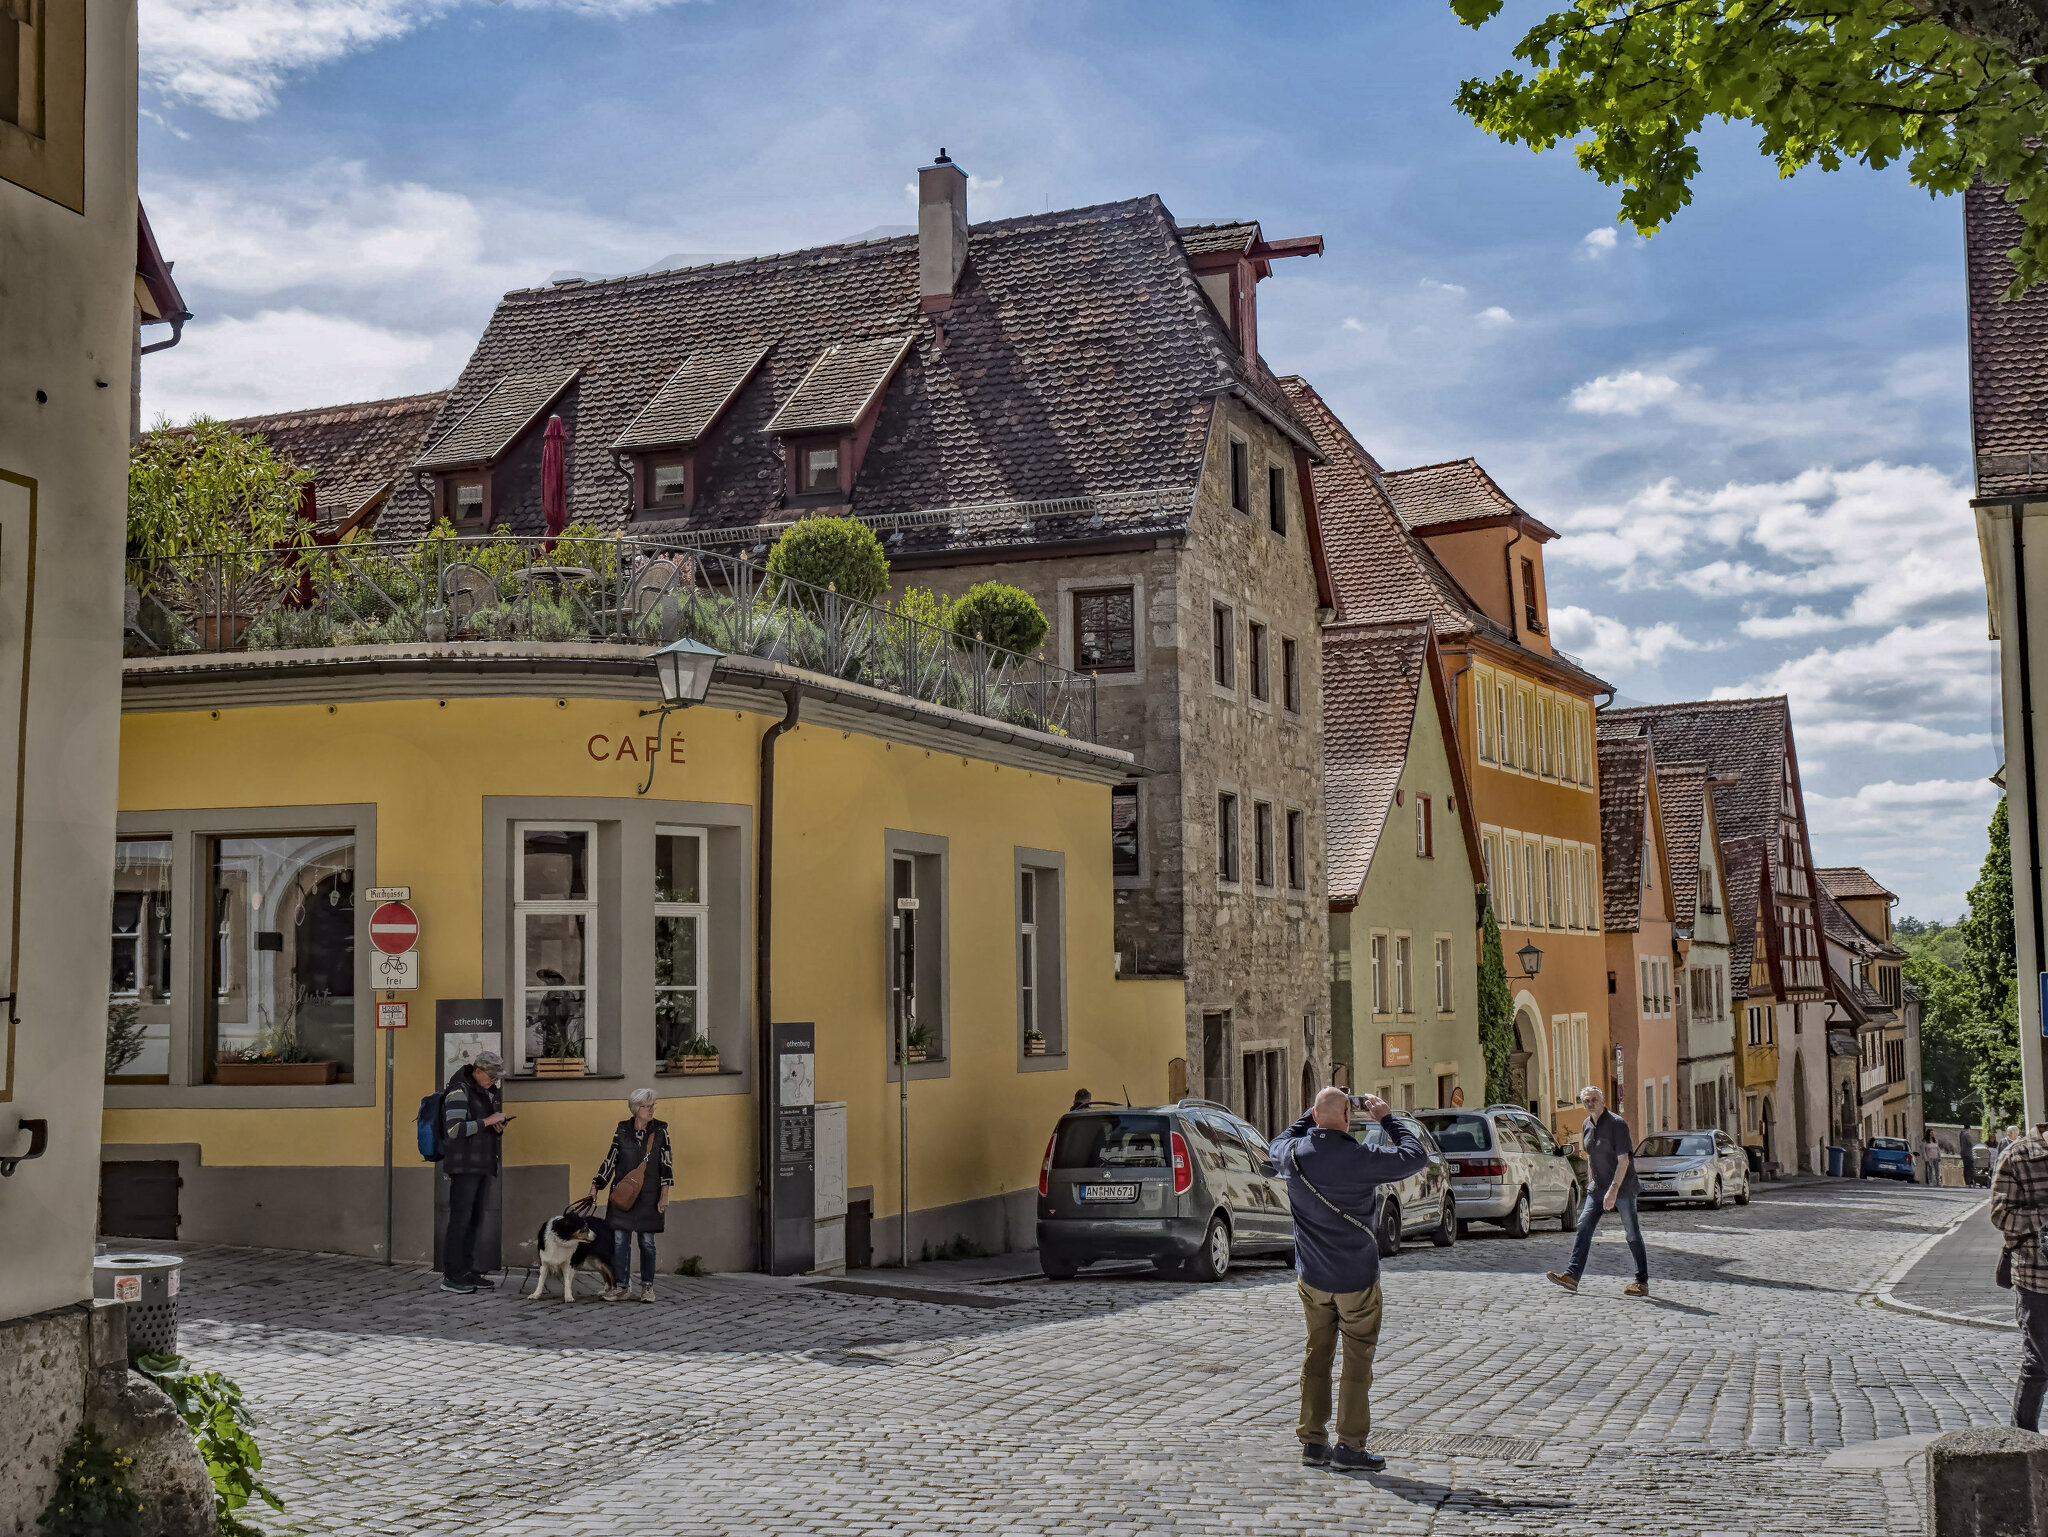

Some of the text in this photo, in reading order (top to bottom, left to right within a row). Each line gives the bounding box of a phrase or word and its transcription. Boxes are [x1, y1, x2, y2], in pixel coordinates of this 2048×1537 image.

[587, 731, 686, 764] CAFÉ
[386, 977, 402, 985] frei
[1086, 1187, 1133, 1197] AN HN 671
[1315, 1192, 1341, 1214] ARMOUR
